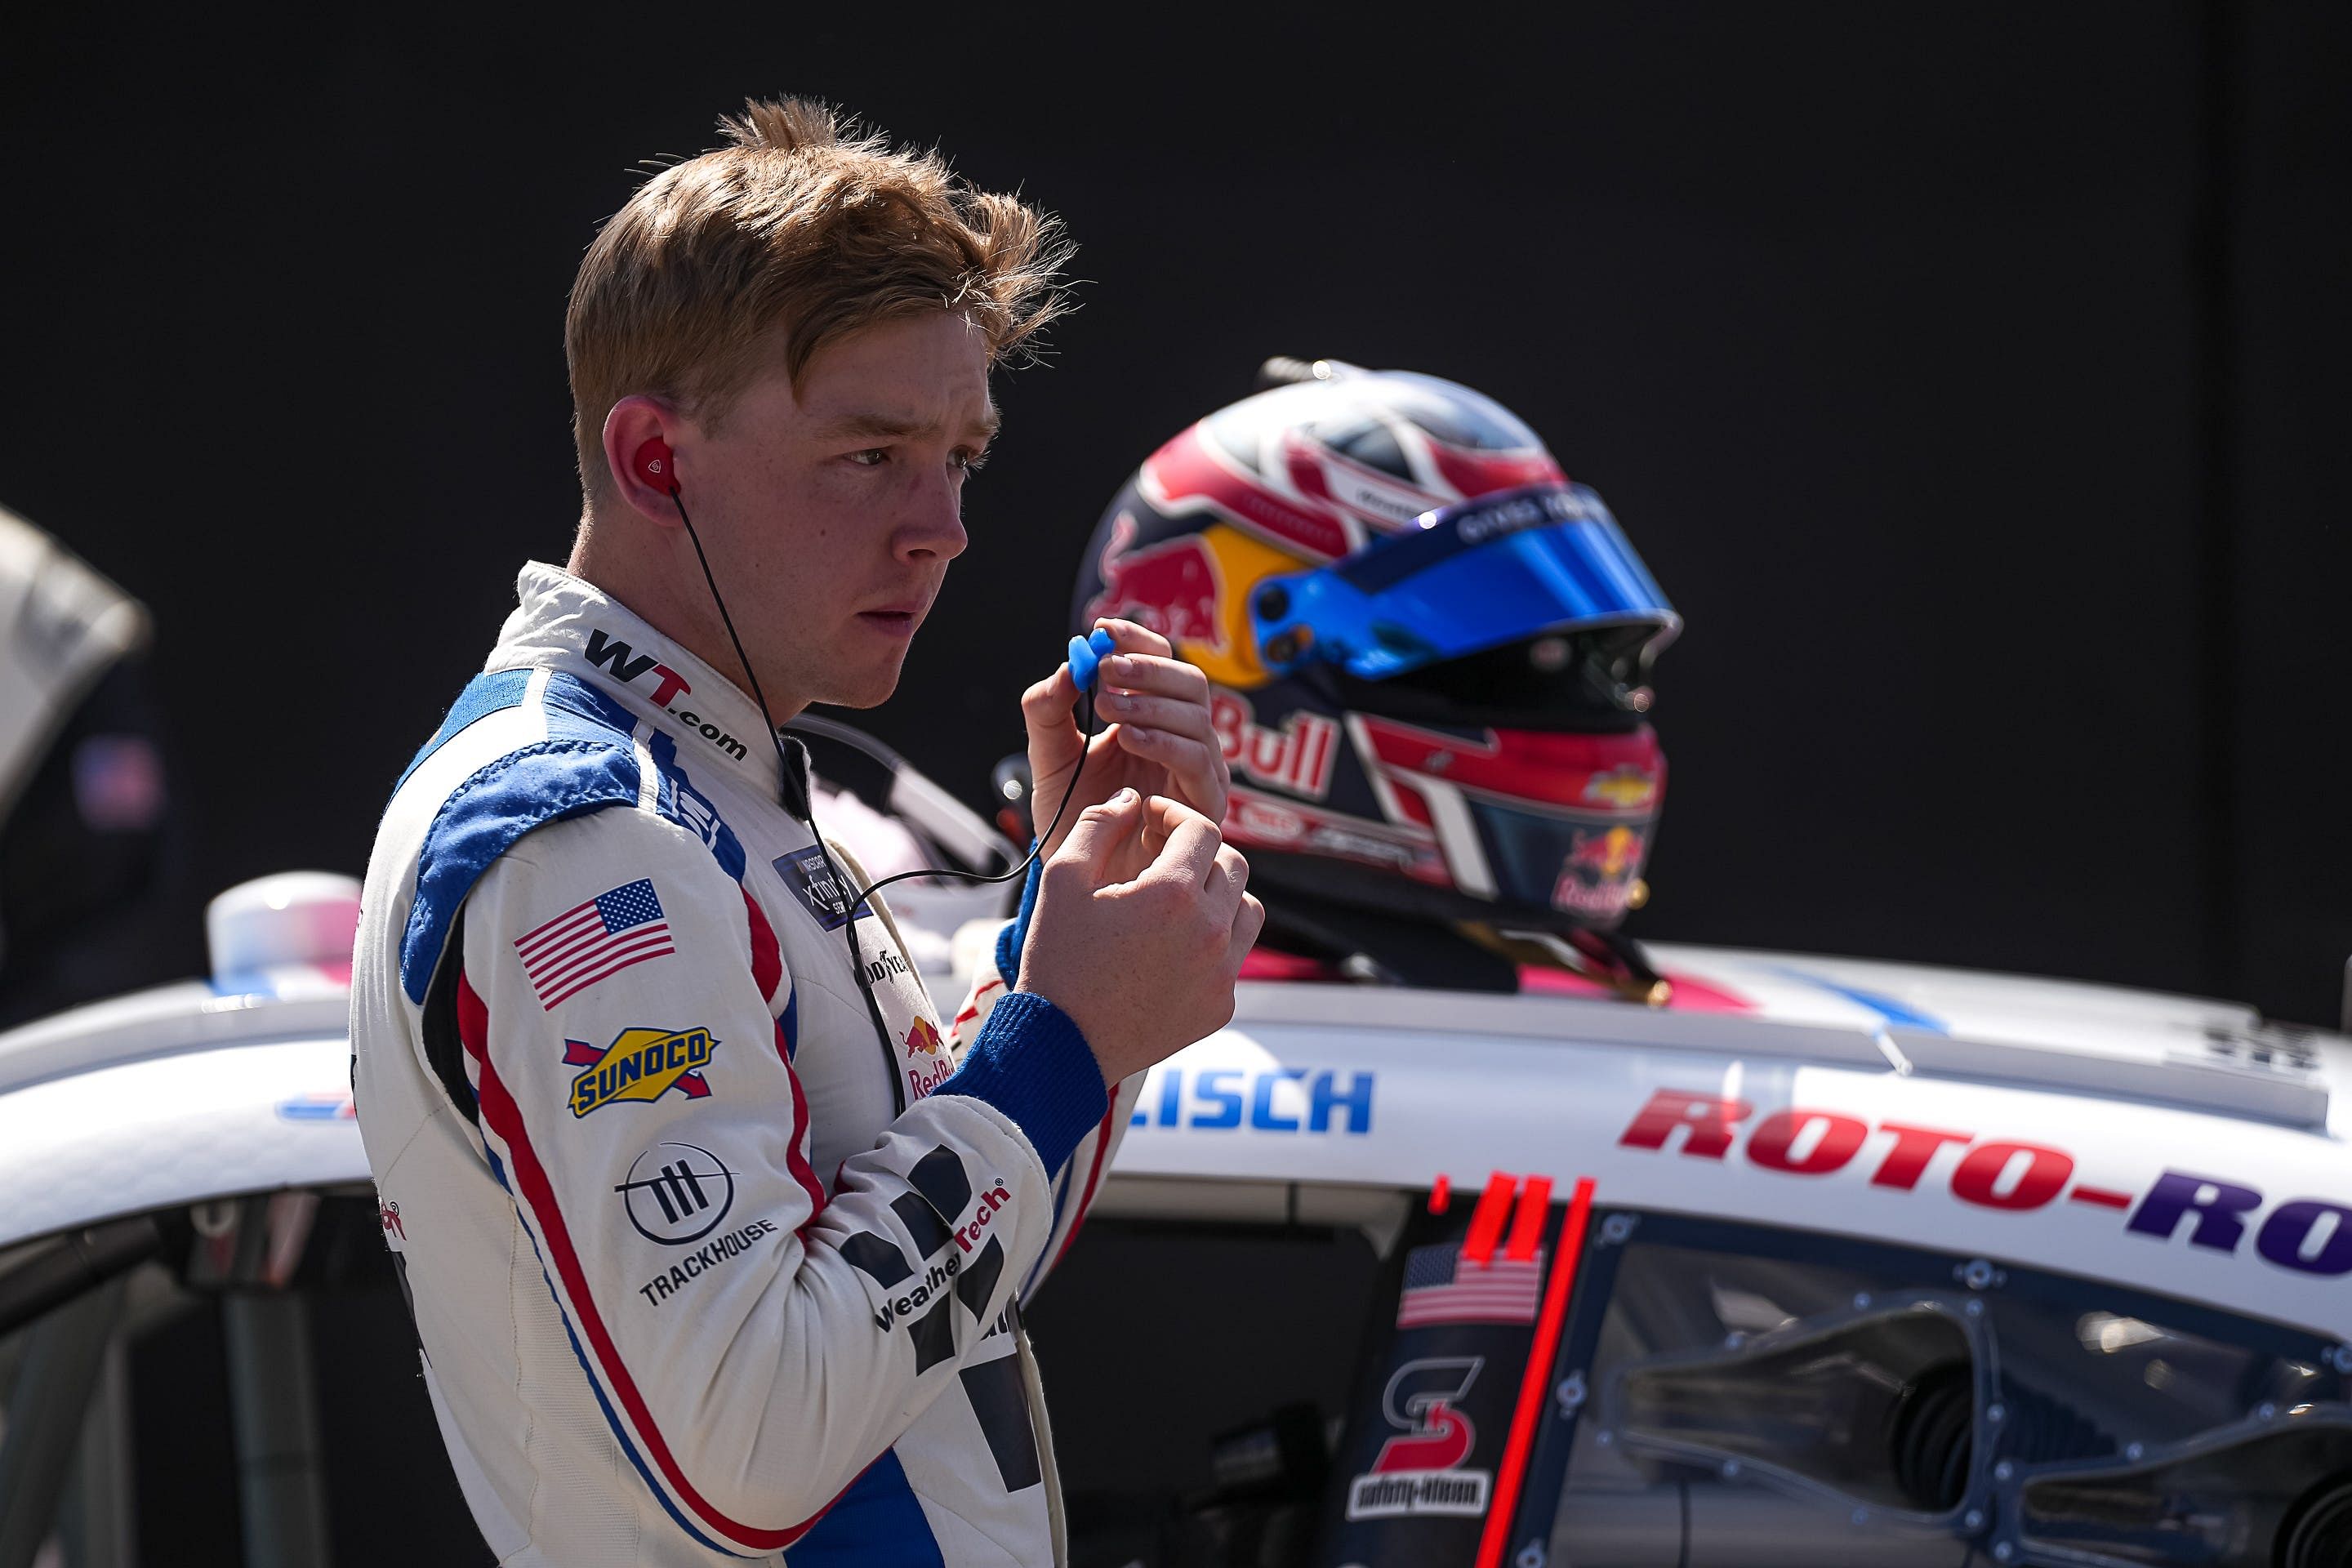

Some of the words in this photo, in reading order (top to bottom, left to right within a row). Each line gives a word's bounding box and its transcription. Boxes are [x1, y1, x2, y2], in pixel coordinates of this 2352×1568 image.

[585, 628, 748, 762] WT.com
[1209, 693, 1338, 796] Bull
[801, 855, 826, 872] NASCAR
[577, 1032, 706, 1111] SUNOCO
[1129, 1067, 1374, 1134] ISCH
[639, 1219, 778, 1307] TRACKHOUSE
